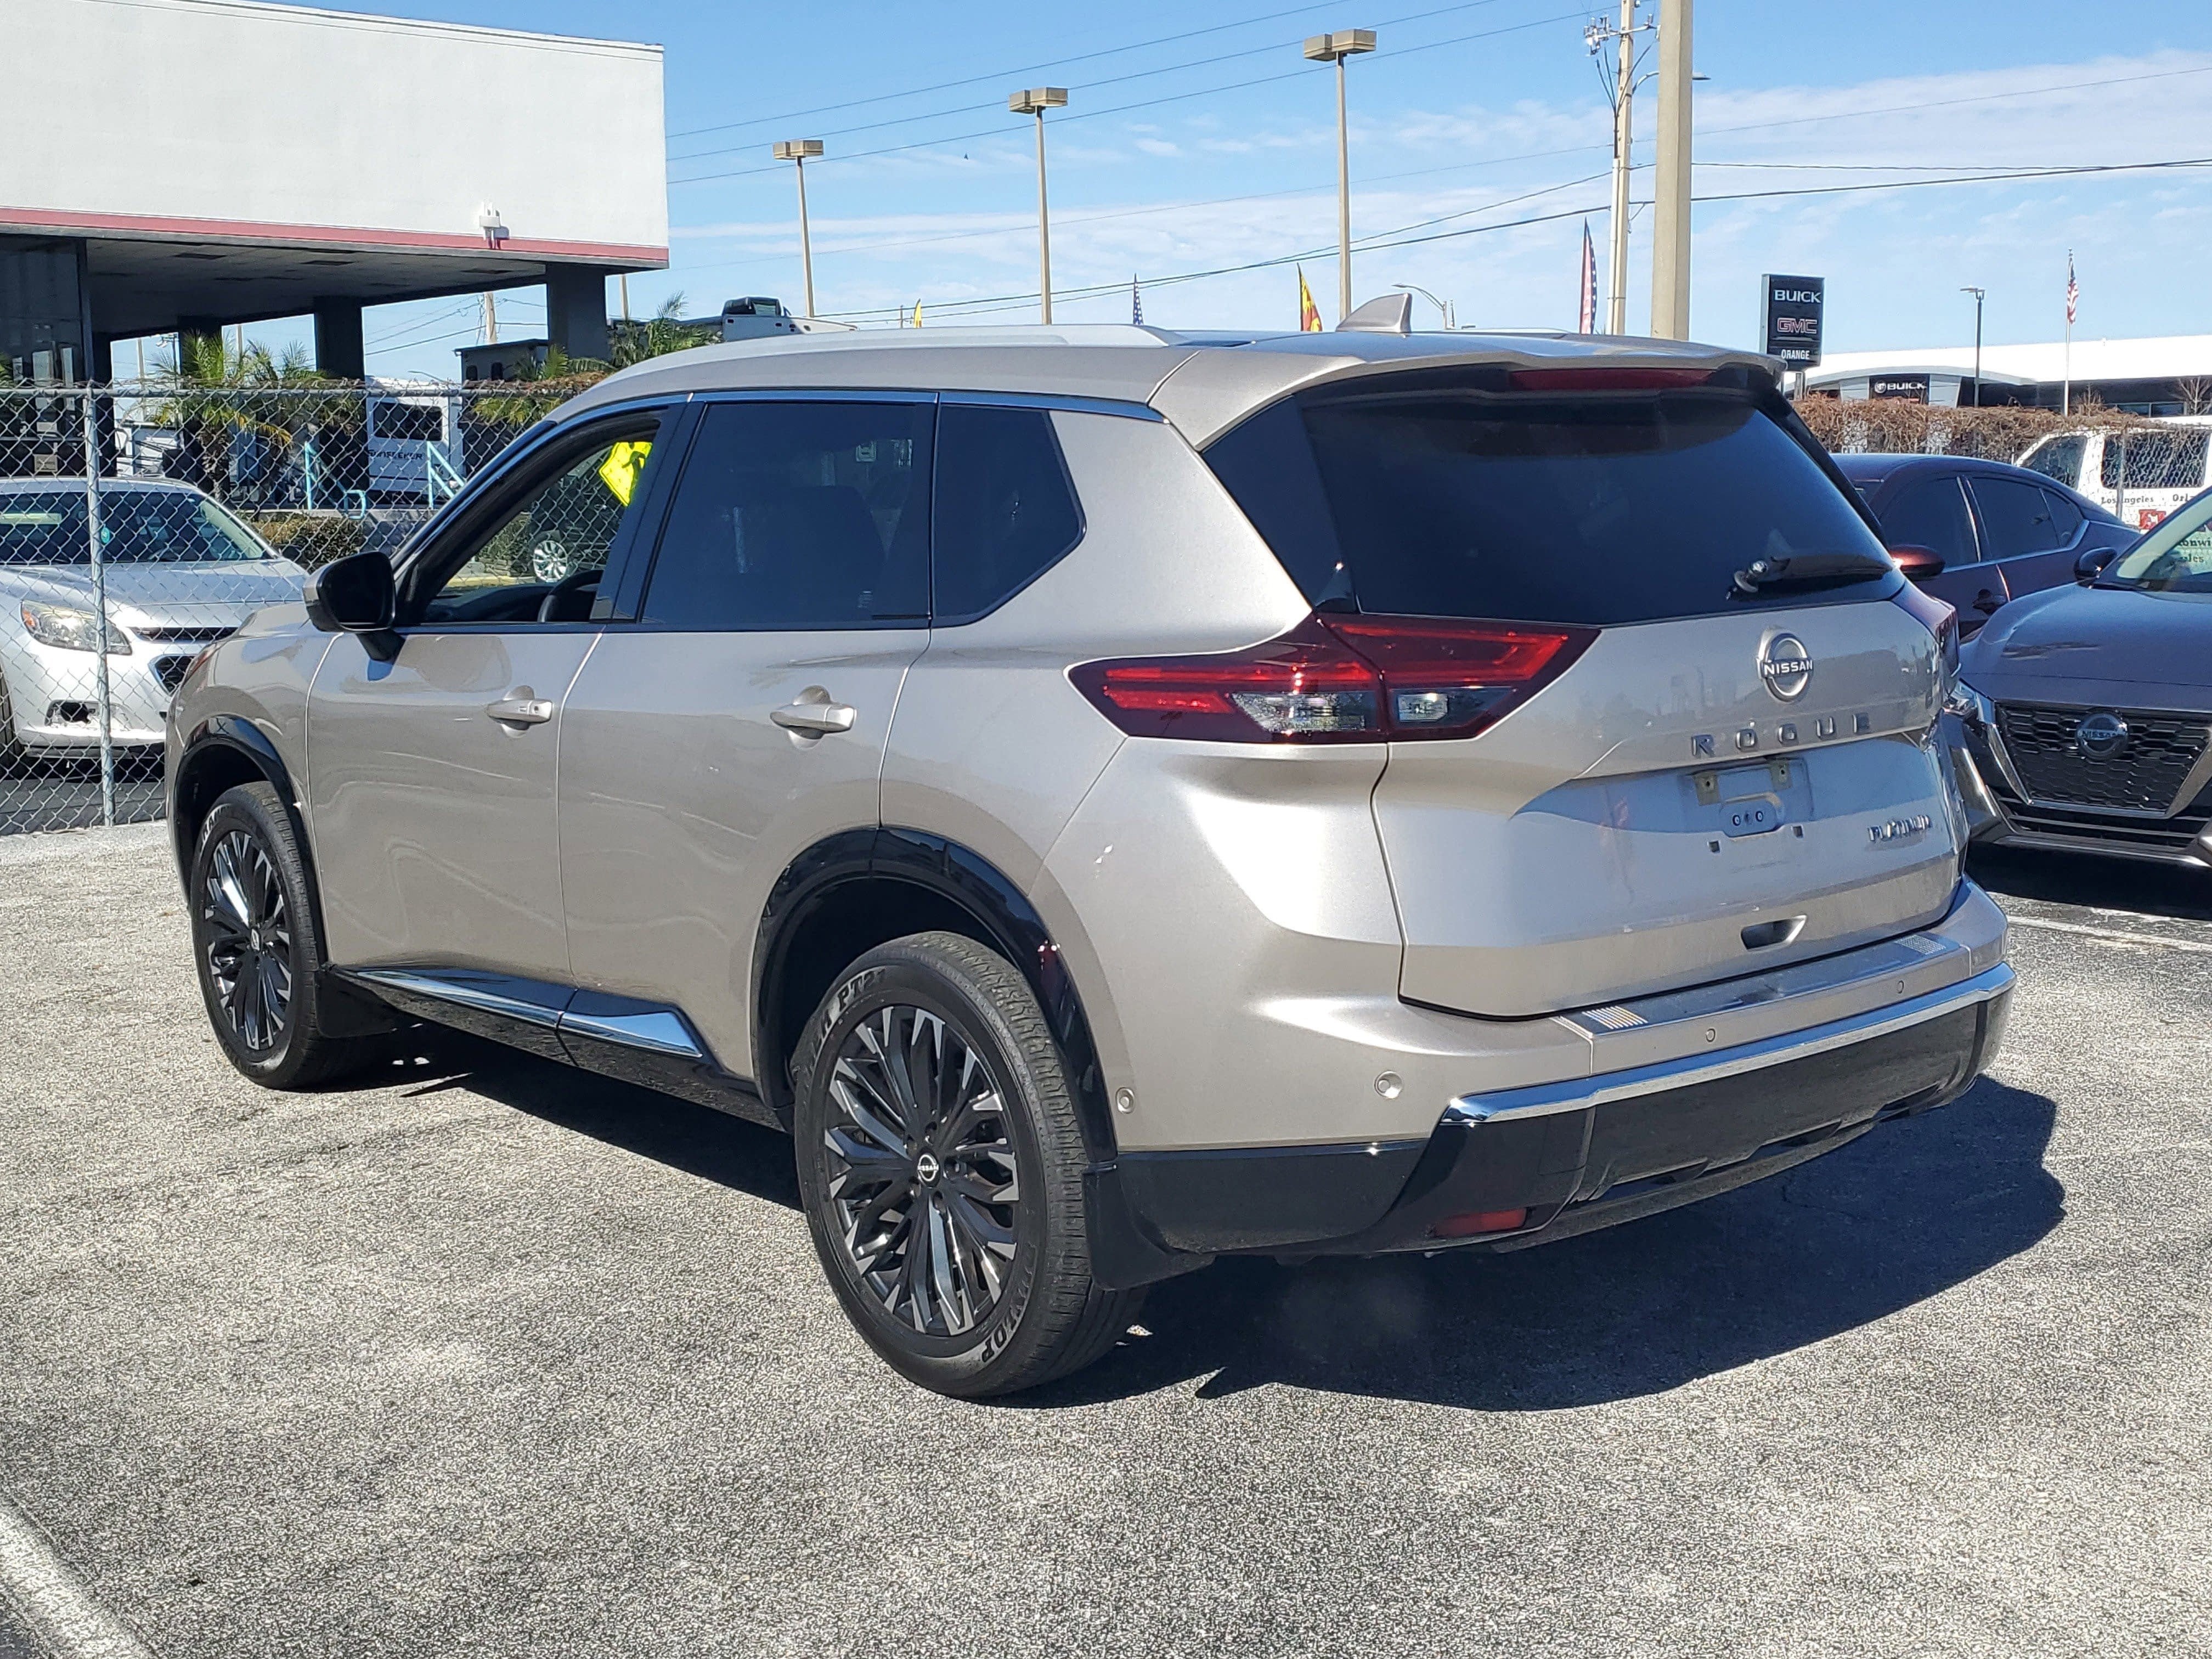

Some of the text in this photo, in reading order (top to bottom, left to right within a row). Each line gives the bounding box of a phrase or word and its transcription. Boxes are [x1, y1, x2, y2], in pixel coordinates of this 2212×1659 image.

[1774, 290, 1821, 303] BUICK
[1777, 317, 1818, 334] GMC
[1781, 349, 1810, 359] ORANGE
[1887, 381, 1927, 390] BUICK
[2121, 495, 2154, 505] ngeles
[2172, 493, 2196, 502] Orl
[1764, 660, 1813, 675] NISSAN
